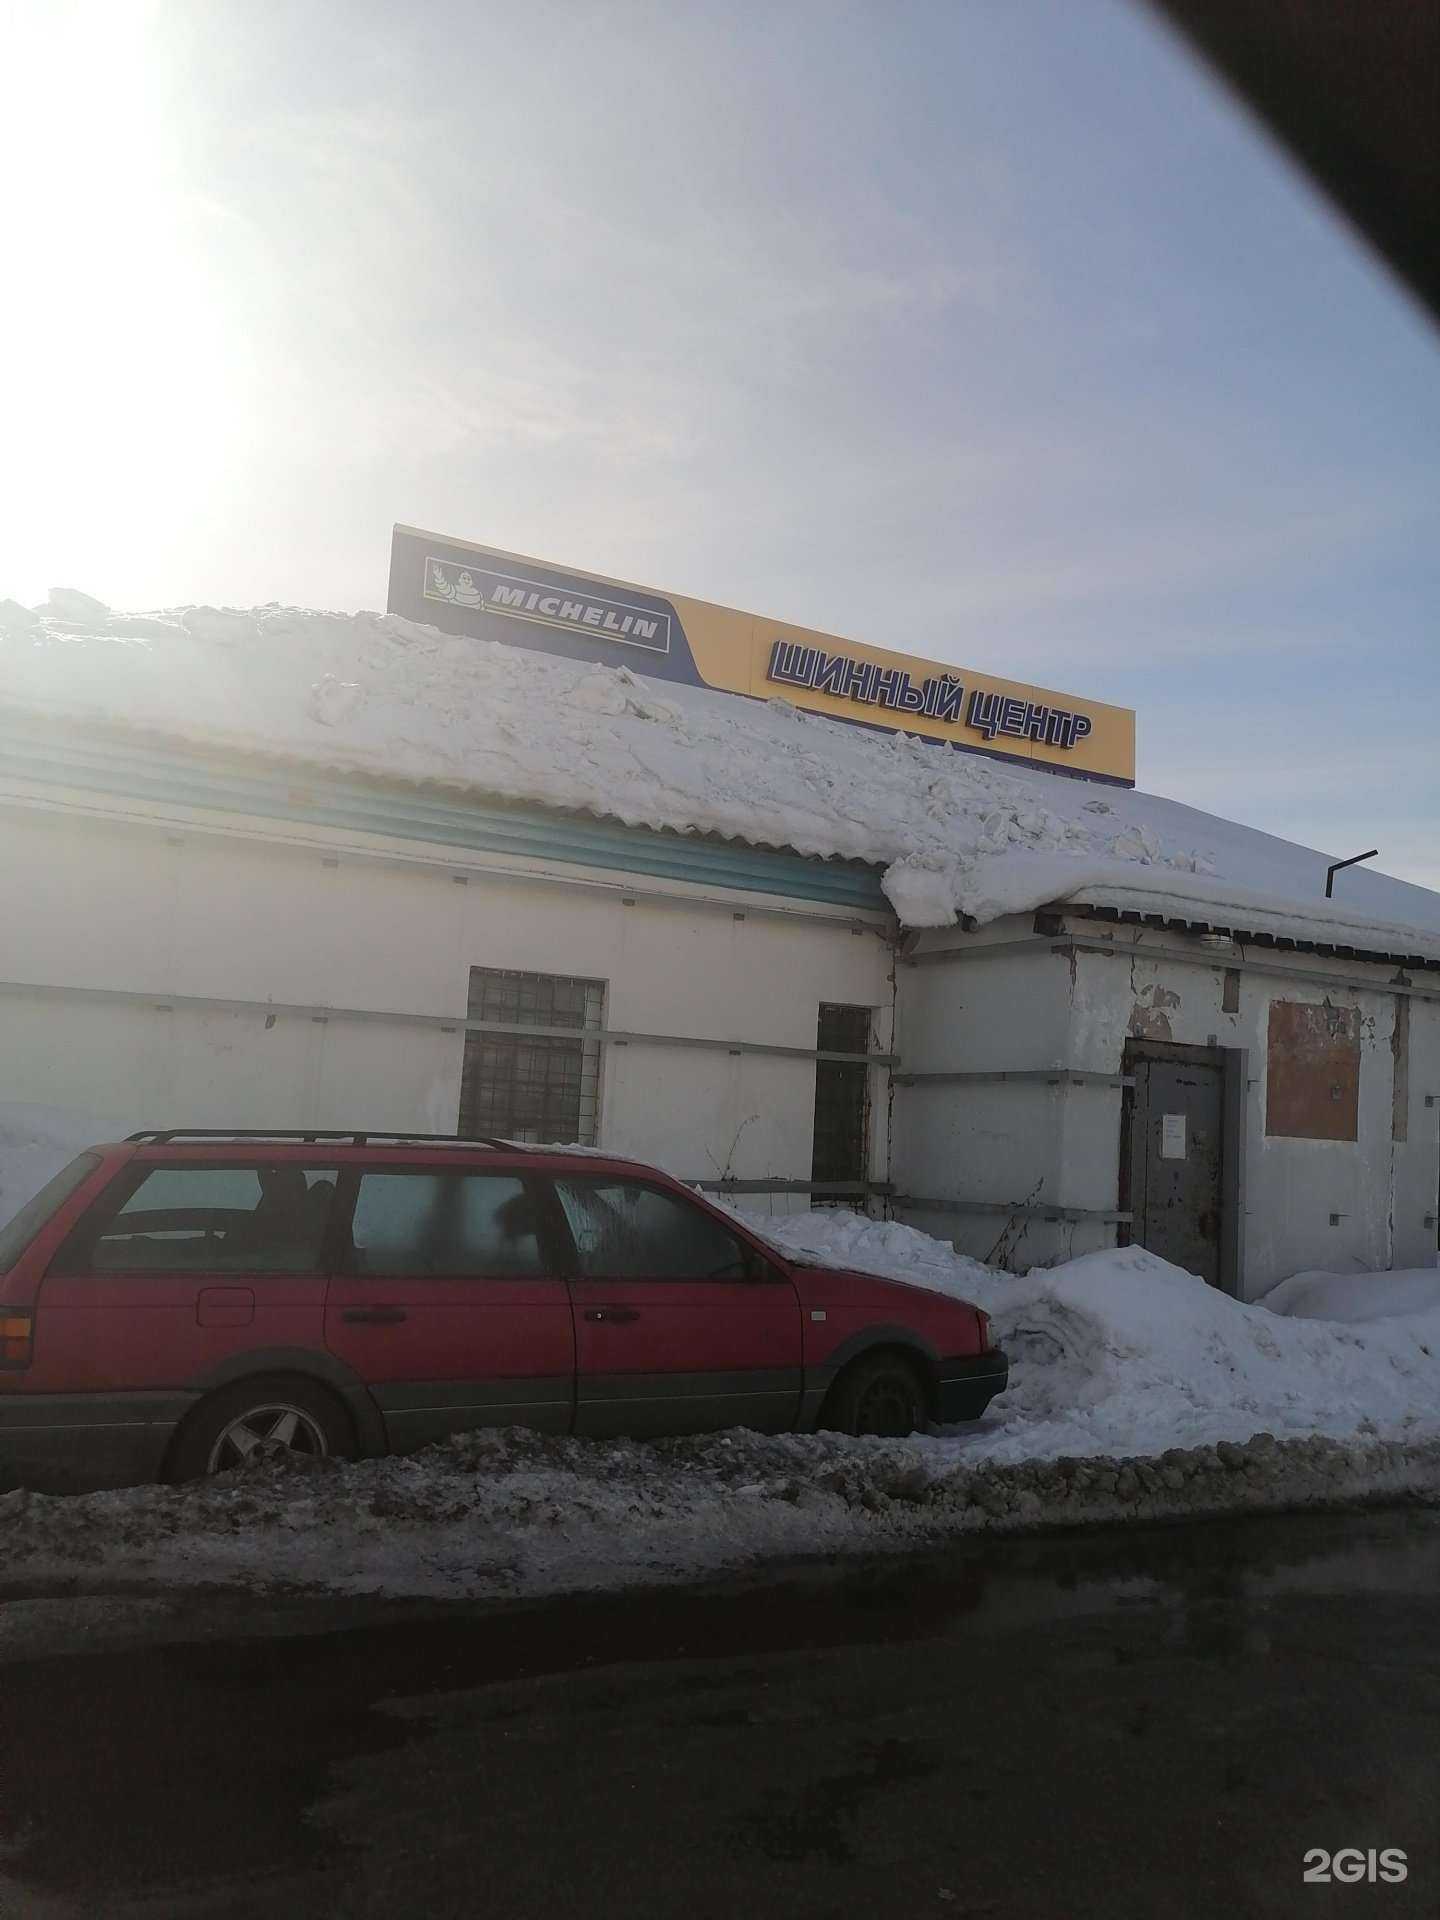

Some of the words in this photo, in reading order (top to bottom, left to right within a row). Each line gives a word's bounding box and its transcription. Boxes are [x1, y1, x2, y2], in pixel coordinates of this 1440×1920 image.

[491, 585, 658, 639] MICHELIN
[769, 640, 964, 723] ШИННЫЙ
[967, 690, 1092, 748] ЦЕНТР
